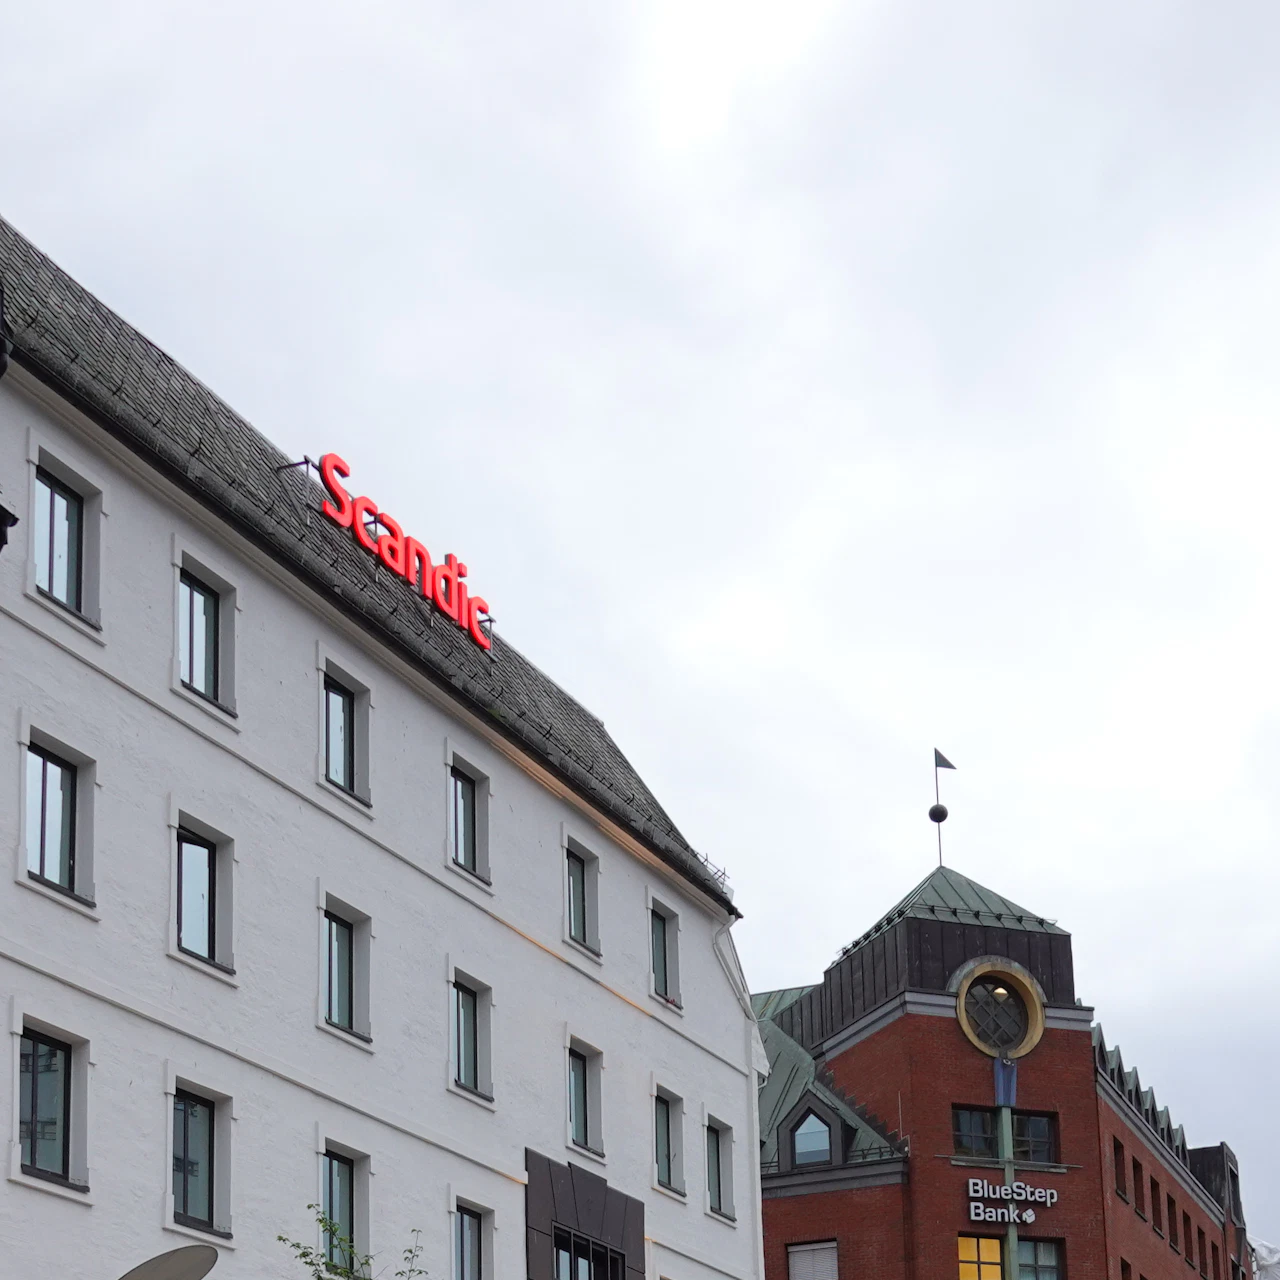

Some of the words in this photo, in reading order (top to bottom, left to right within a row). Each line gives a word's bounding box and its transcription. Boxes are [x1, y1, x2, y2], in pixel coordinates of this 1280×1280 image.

[319, 453, 491, 650] Scandic
[968, 1178, 1058, 1207] BlueStep
[970, 1202, 1021, 1223] Bank
